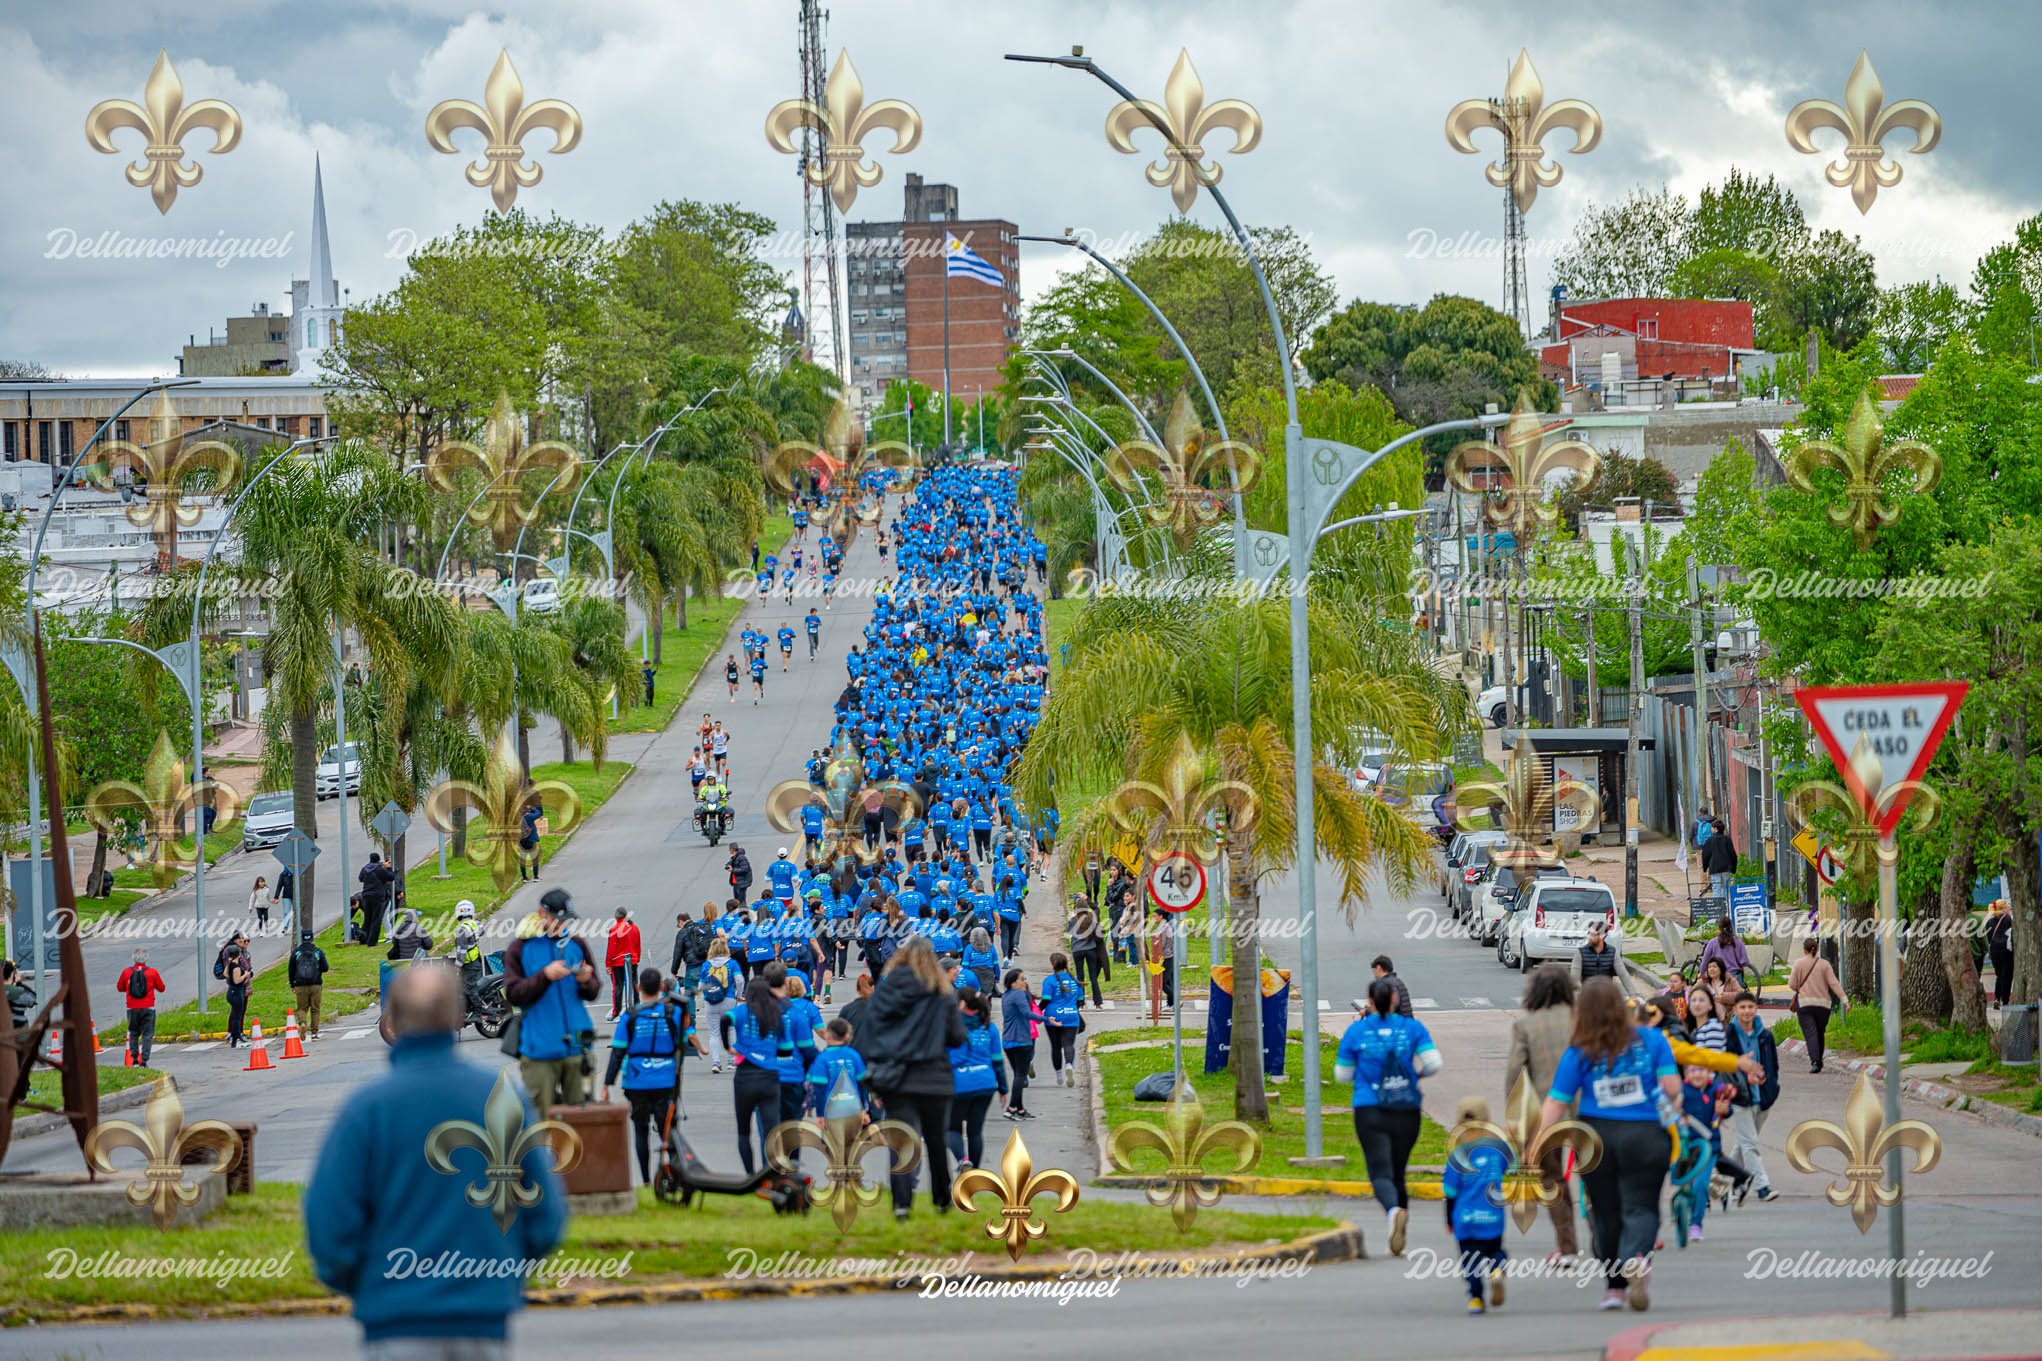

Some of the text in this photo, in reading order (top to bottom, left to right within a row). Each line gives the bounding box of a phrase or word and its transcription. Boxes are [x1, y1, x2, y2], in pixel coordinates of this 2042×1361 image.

[1843, 708, 1923, 730] CEDA EL
[1559, 817, 1592, 825] SHOPP
[1161, 866, 1192, 888] 45
